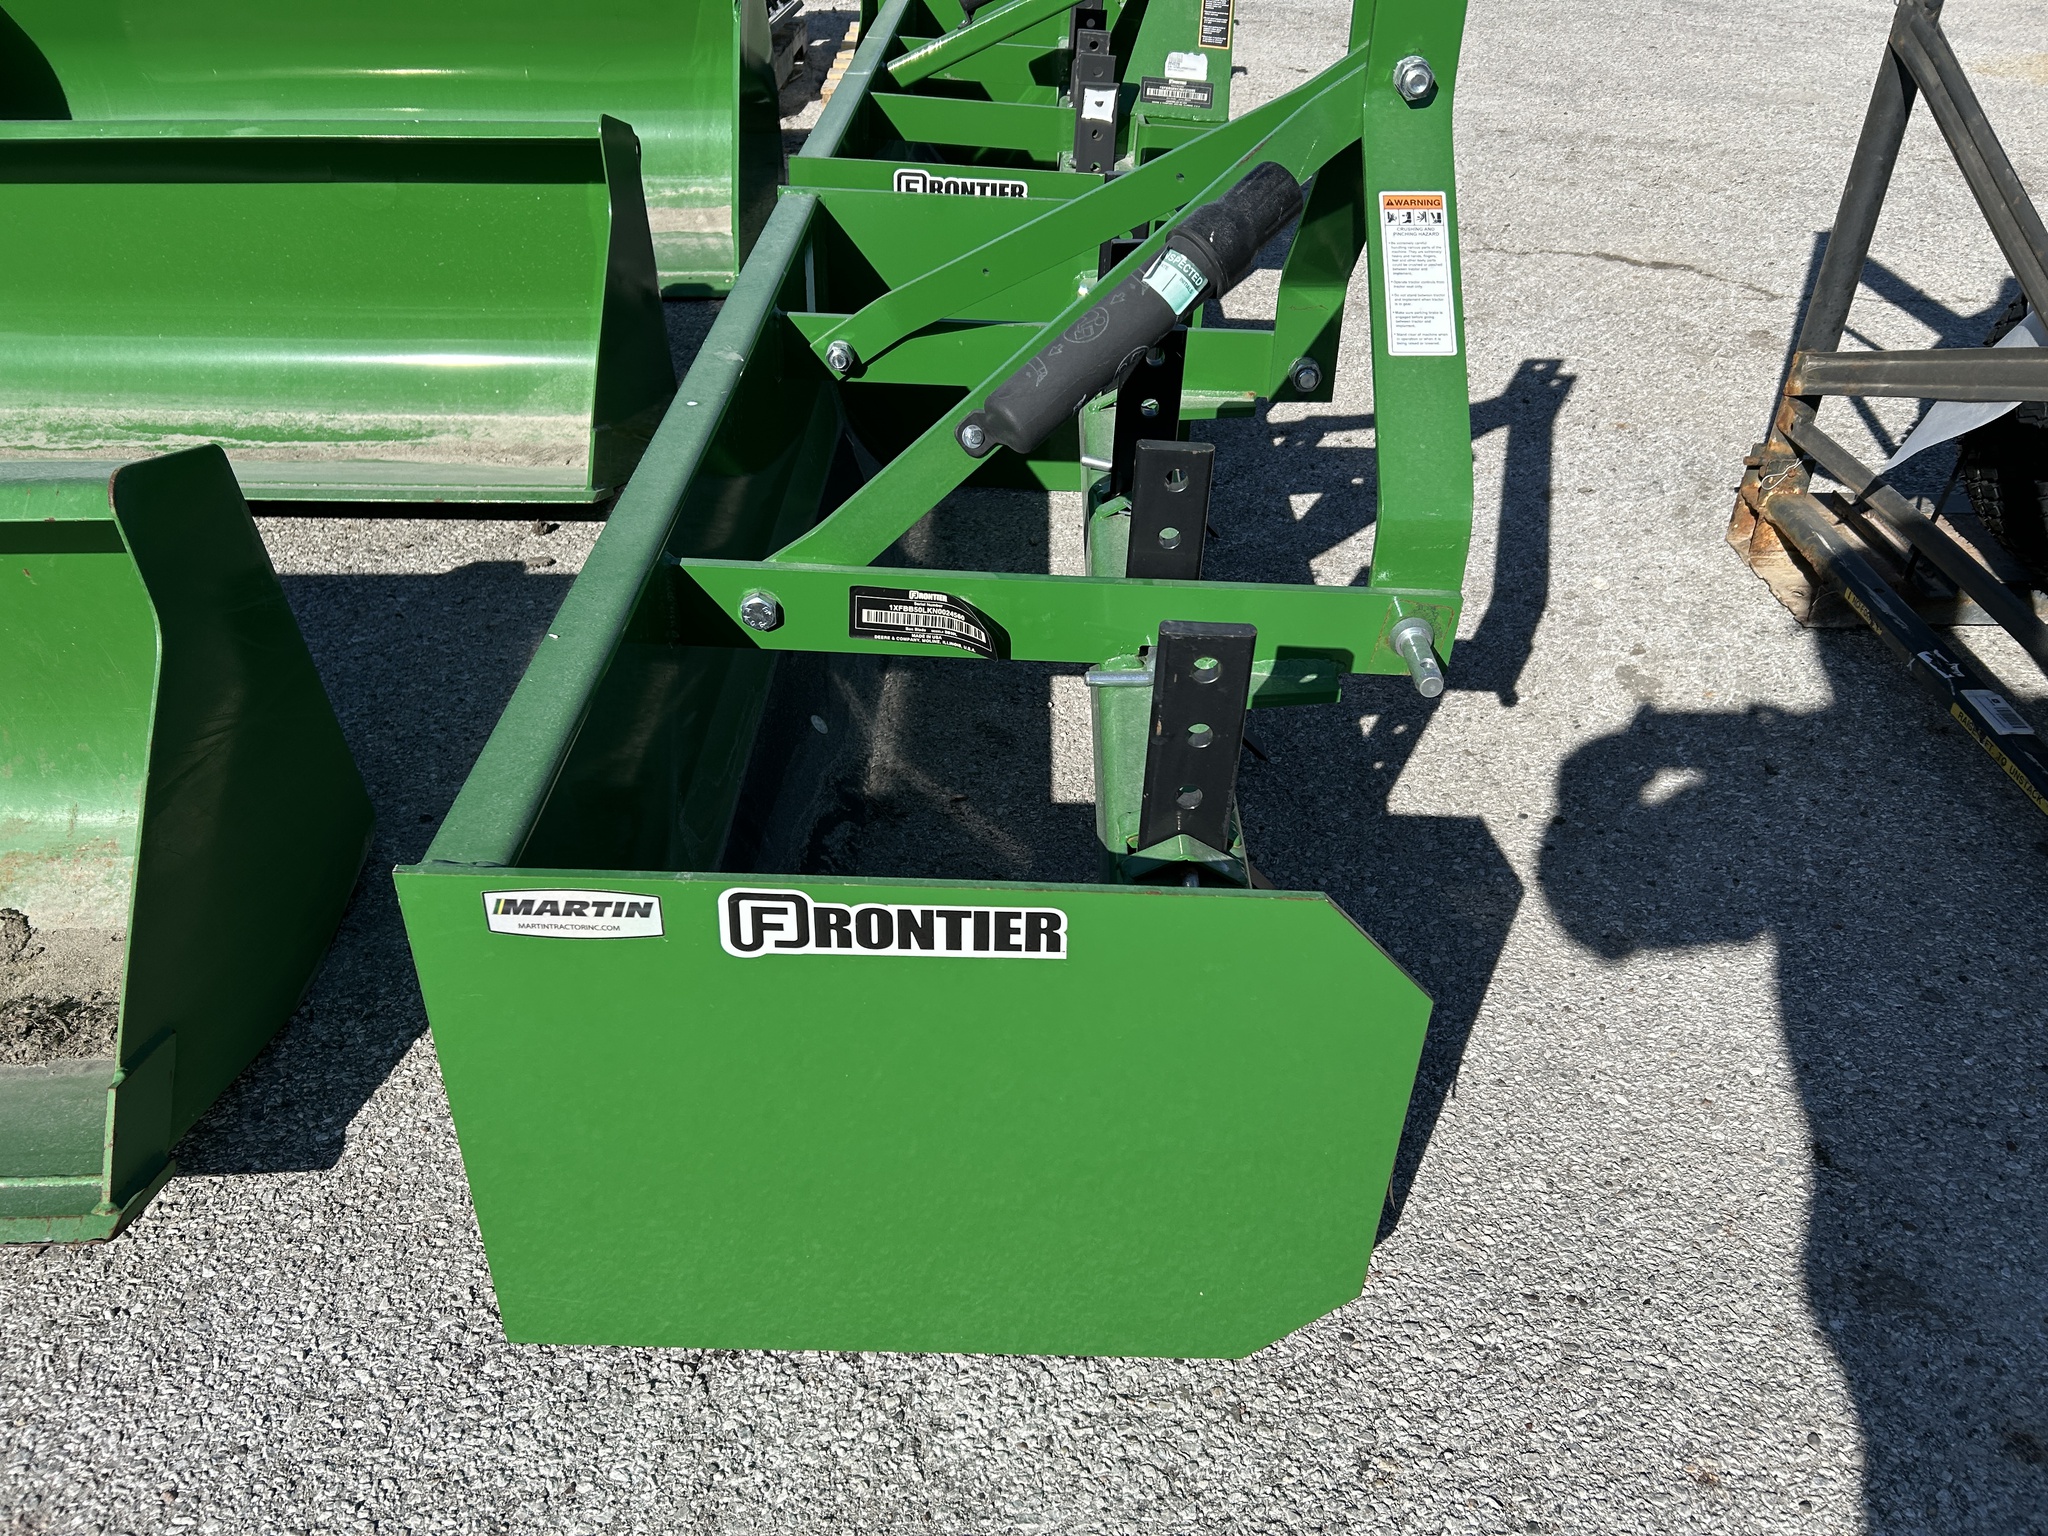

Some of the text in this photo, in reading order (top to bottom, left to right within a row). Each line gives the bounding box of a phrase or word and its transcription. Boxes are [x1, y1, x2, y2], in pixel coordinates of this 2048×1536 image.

[1394, 199, 1441, 207] WARNING
[1164, 251, 1203, 287] NSPECTED
[908, 590, 948, 602] FRONTIER
[1996, 752, 2007, 767] TO
[2009, 763, 2043, 805] UNSTACK
[501, 898, 655, 919] MARTIN
[517, 922, 621, 932] MARTINTRACTORINC.COM
[727, 891, 1063, 953] FRONTIER
